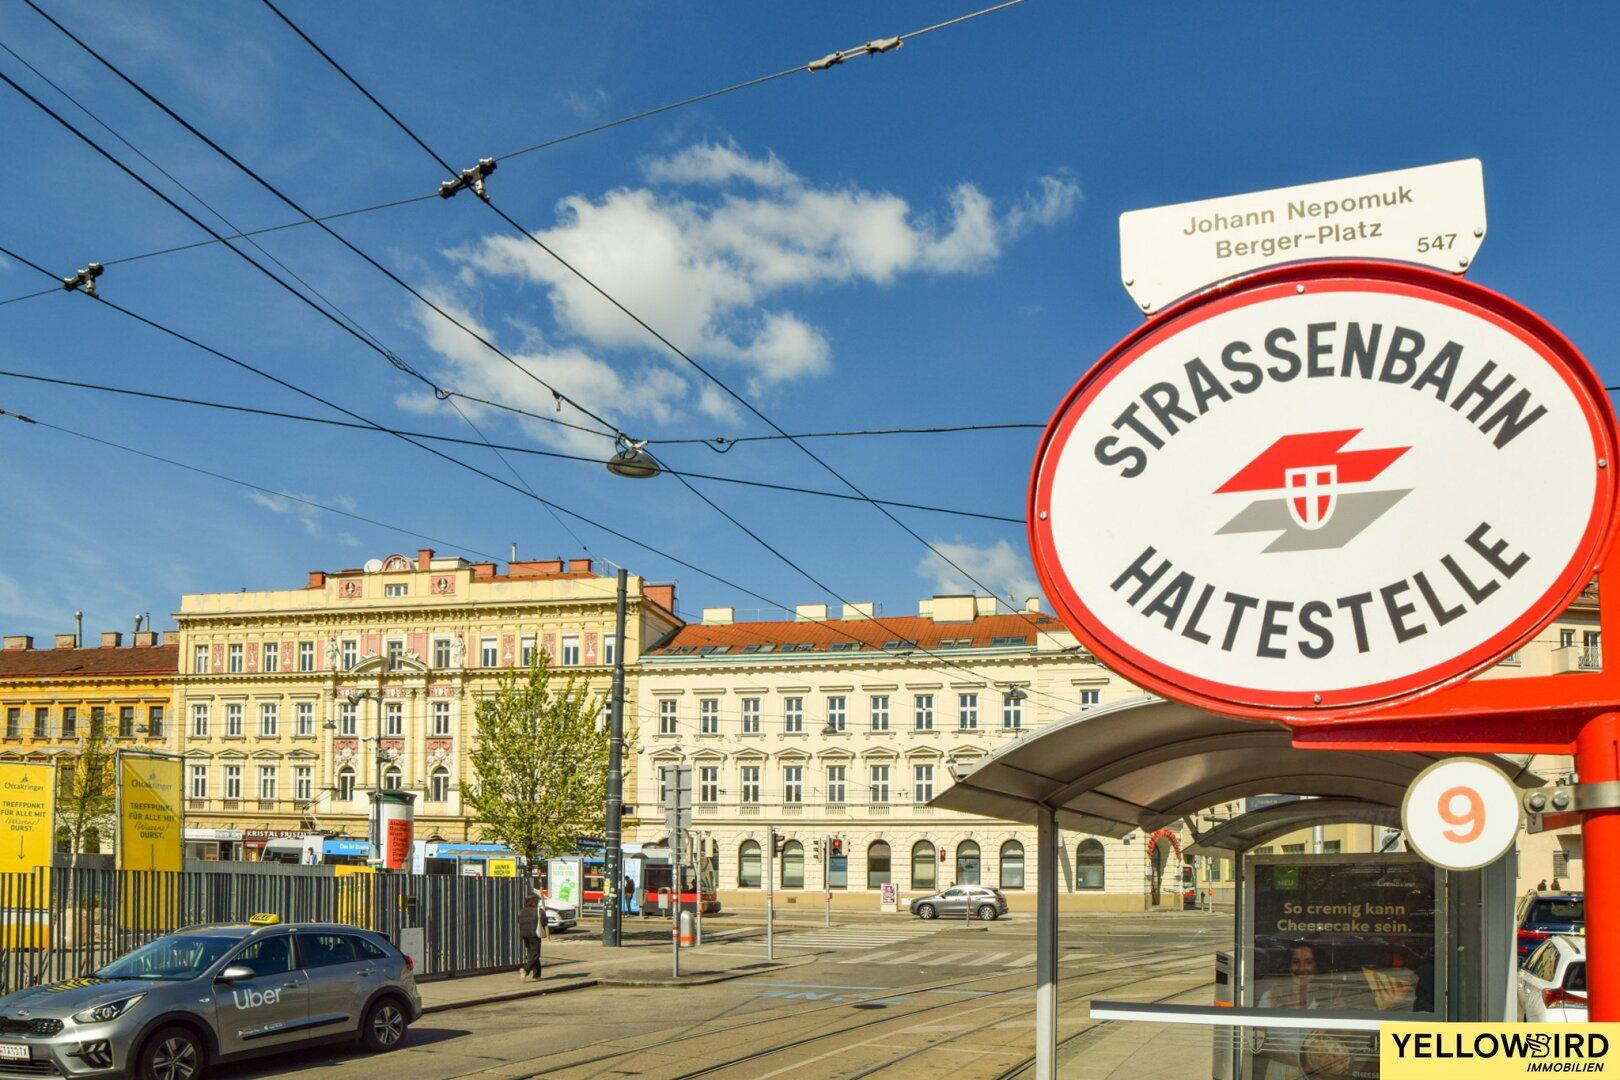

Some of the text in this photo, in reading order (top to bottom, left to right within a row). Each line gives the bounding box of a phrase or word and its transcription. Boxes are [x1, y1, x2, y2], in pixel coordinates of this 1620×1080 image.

[1183, 186, 1414, 236] Johann Nepomuk
[1215, 221, 1383, 259] Berger-Platz
[1417, 234, 1458, 253] 547
[1094, 321, 1548, 479] STRASSENBAHN
[1110, 521, 1532, 660] HALTESTELLE
[4, 782, 44, 792] Ottakringer
[0, 808, 13, 816] FÜR
[15, 809, 33, 817] ALLE
[3, 801, 45, 809] TREFFPUNKT
[1437, 786, 1486, 843] 9
[128, 812, 143, 820] FÜR
[144, 813, 161, 821] ALLE
[1284, 902, 1405, 918] So cremig kann
[1277, 919, 1412, 933] Cheesecake sein.
[233, 988, 282, 1010] Uber
